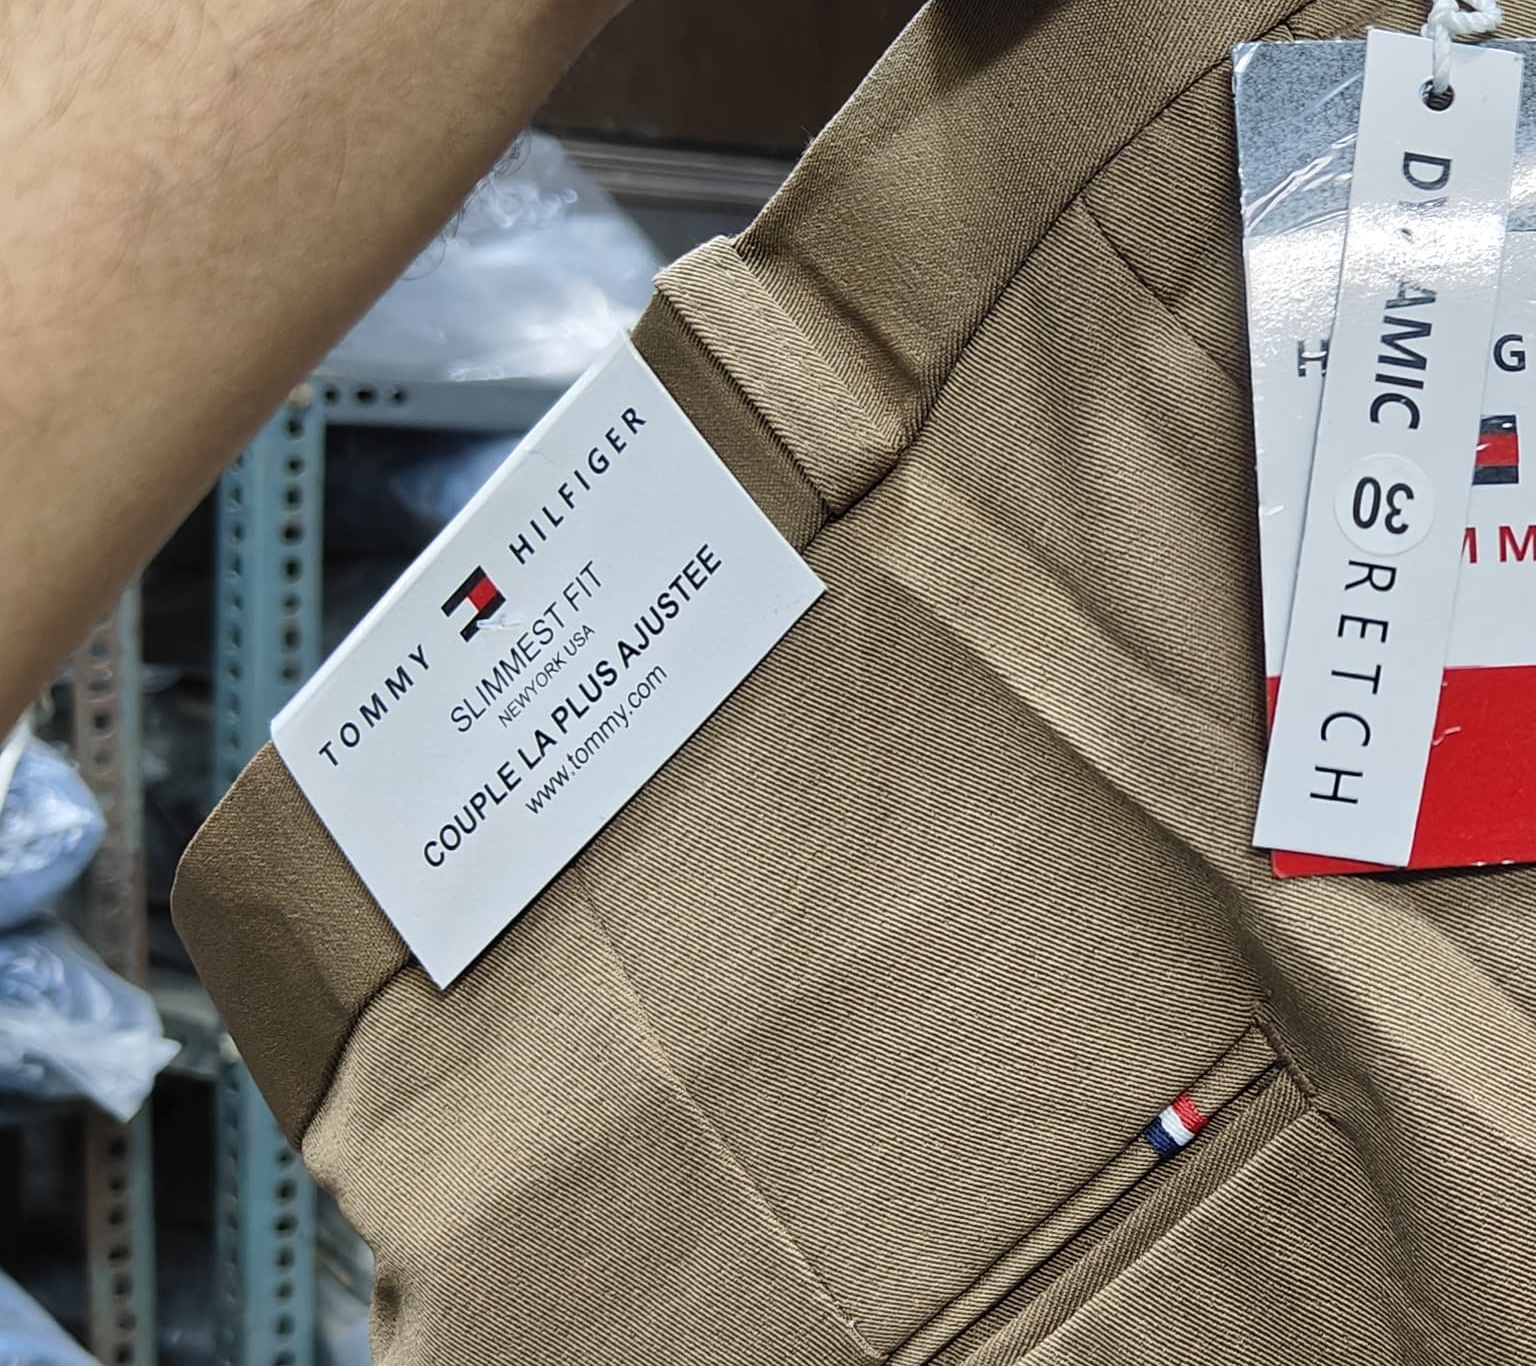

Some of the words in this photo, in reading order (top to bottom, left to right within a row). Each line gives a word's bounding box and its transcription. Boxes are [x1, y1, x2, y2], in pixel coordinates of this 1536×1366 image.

[1370, 151, 1452, 430] DAMIC
[318, 644, 430, 767] TOMMY
[508, 407, 647, 565] HILFIGER
[1352, 476, 1415, 535] 30
[423, 760, 523, 868] COUPLE
[517, 729, 558, 771] LA
[550, 660, 619, 735] PLUS
[617, 543, 723, 671] AJUSTEE
[450, 601, 565, 733] SLIMMEST
[562, 560, 602, 612] FIT
[497, 651, 567, 728] NEWYORK
[563, 624, 596, 657] USA
[525, 665, 668, 815] www.tommy.com
[1309, 559, 1397, 805] RETCH
